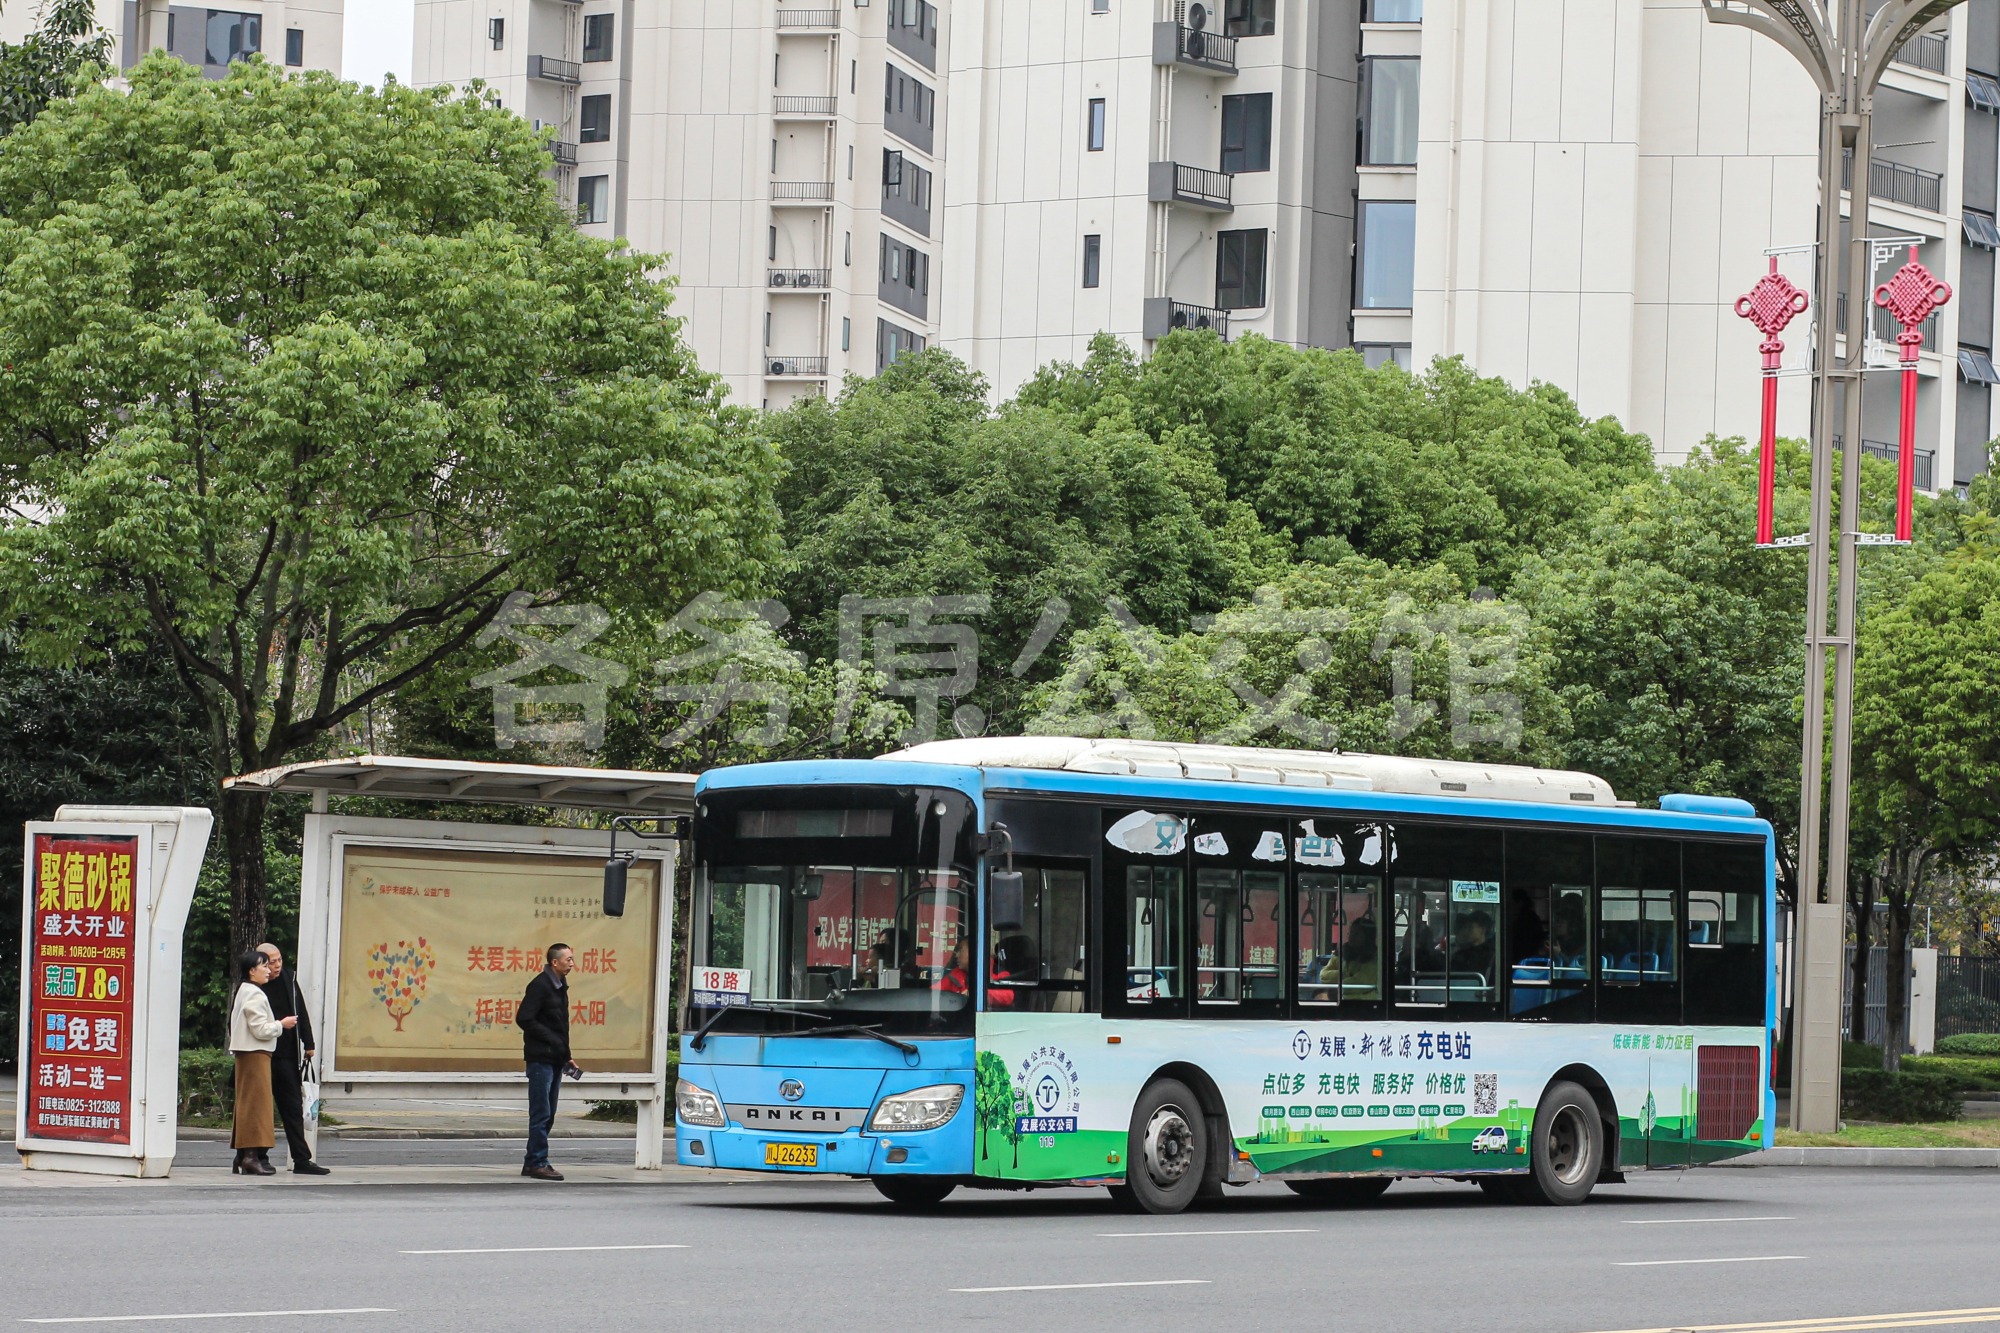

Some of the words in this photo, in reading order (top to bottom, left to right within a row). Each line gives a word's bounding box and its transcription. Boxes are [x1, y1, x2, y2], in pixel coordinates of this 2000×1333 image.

[40, 851, 131, 912] 聚德砂锅
[424, 888, 451, 897] 公益广告
[43, 914, 125, 938] 盛大开业
[703, 971, 739, 990] 18路
[475, 998, 606, 1026] 托起太阳
[46, 1014, 66, 1031] 雪花
[46, 1034, 66, 1051] 啤酒
[67, 1017, 118, 1052] 免费
[39, 1063, 122, 1090] 活动二选一
[1262, 1072, 1305, 1095] 点位多
[1317, 1072, 1360, 1095] 充电快
[1371, 1072, 1414, 1094] 服务好
[1425, 1072, 1466, 1094] 价格优
[746, 1108, 841, 1121] ANKAI
[1021, 1118, 1074, 1132] 发展公交公司
[1039, 1136, 1055, 1148] 119
